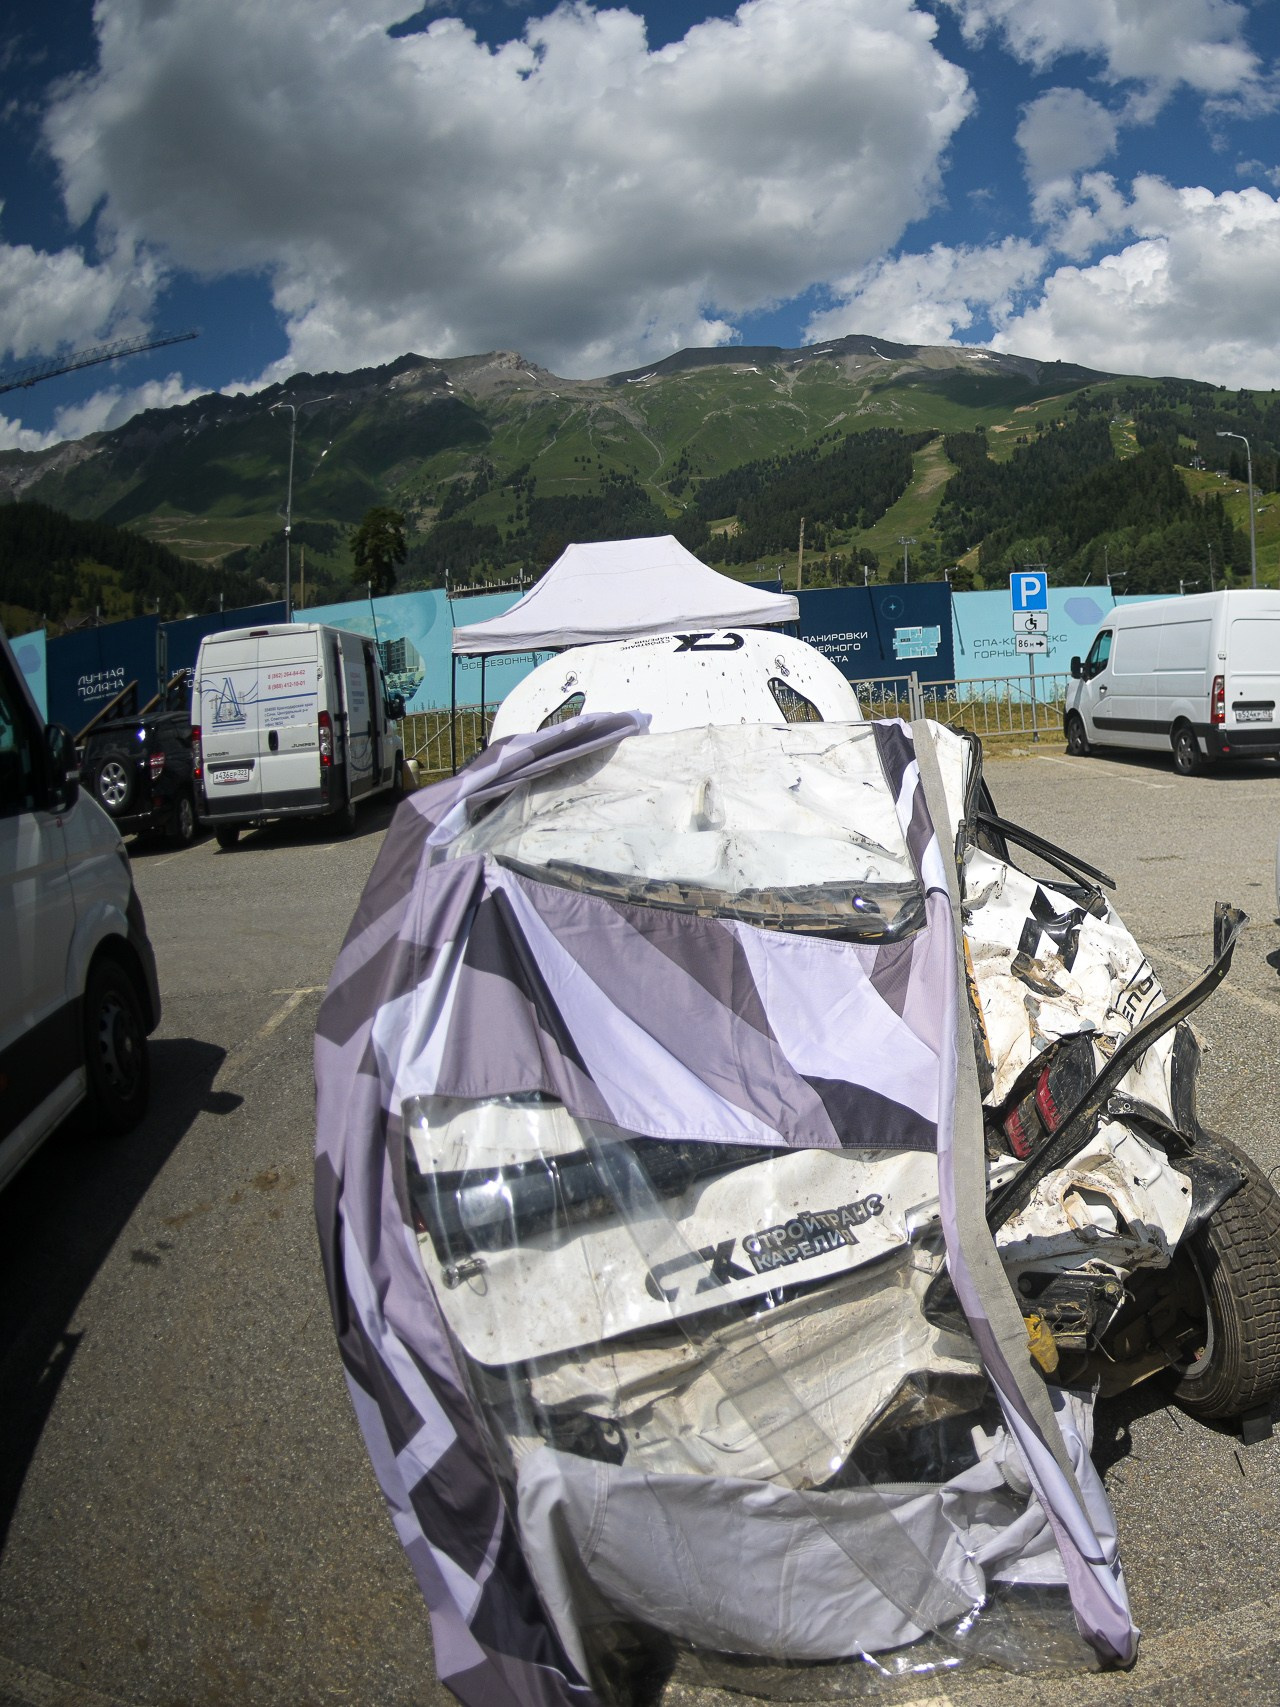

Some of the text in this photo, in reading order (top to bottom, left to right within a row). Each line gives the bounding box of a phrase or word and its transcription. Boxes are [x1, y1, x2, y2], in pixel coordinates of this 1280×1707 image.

[1020, 577, 1041, 607] P
[973, 634, 1068, 648] СПА-КОЕКС
[78, 667, 124, 686] ЛУННАЯ
[78, 680, 124, 696] ПОЛЯНА
[745, 1194, 884, 1253] СТРОЙТРАНС
[752, 1229, 857, 1272] КАРЕЛИЯ
